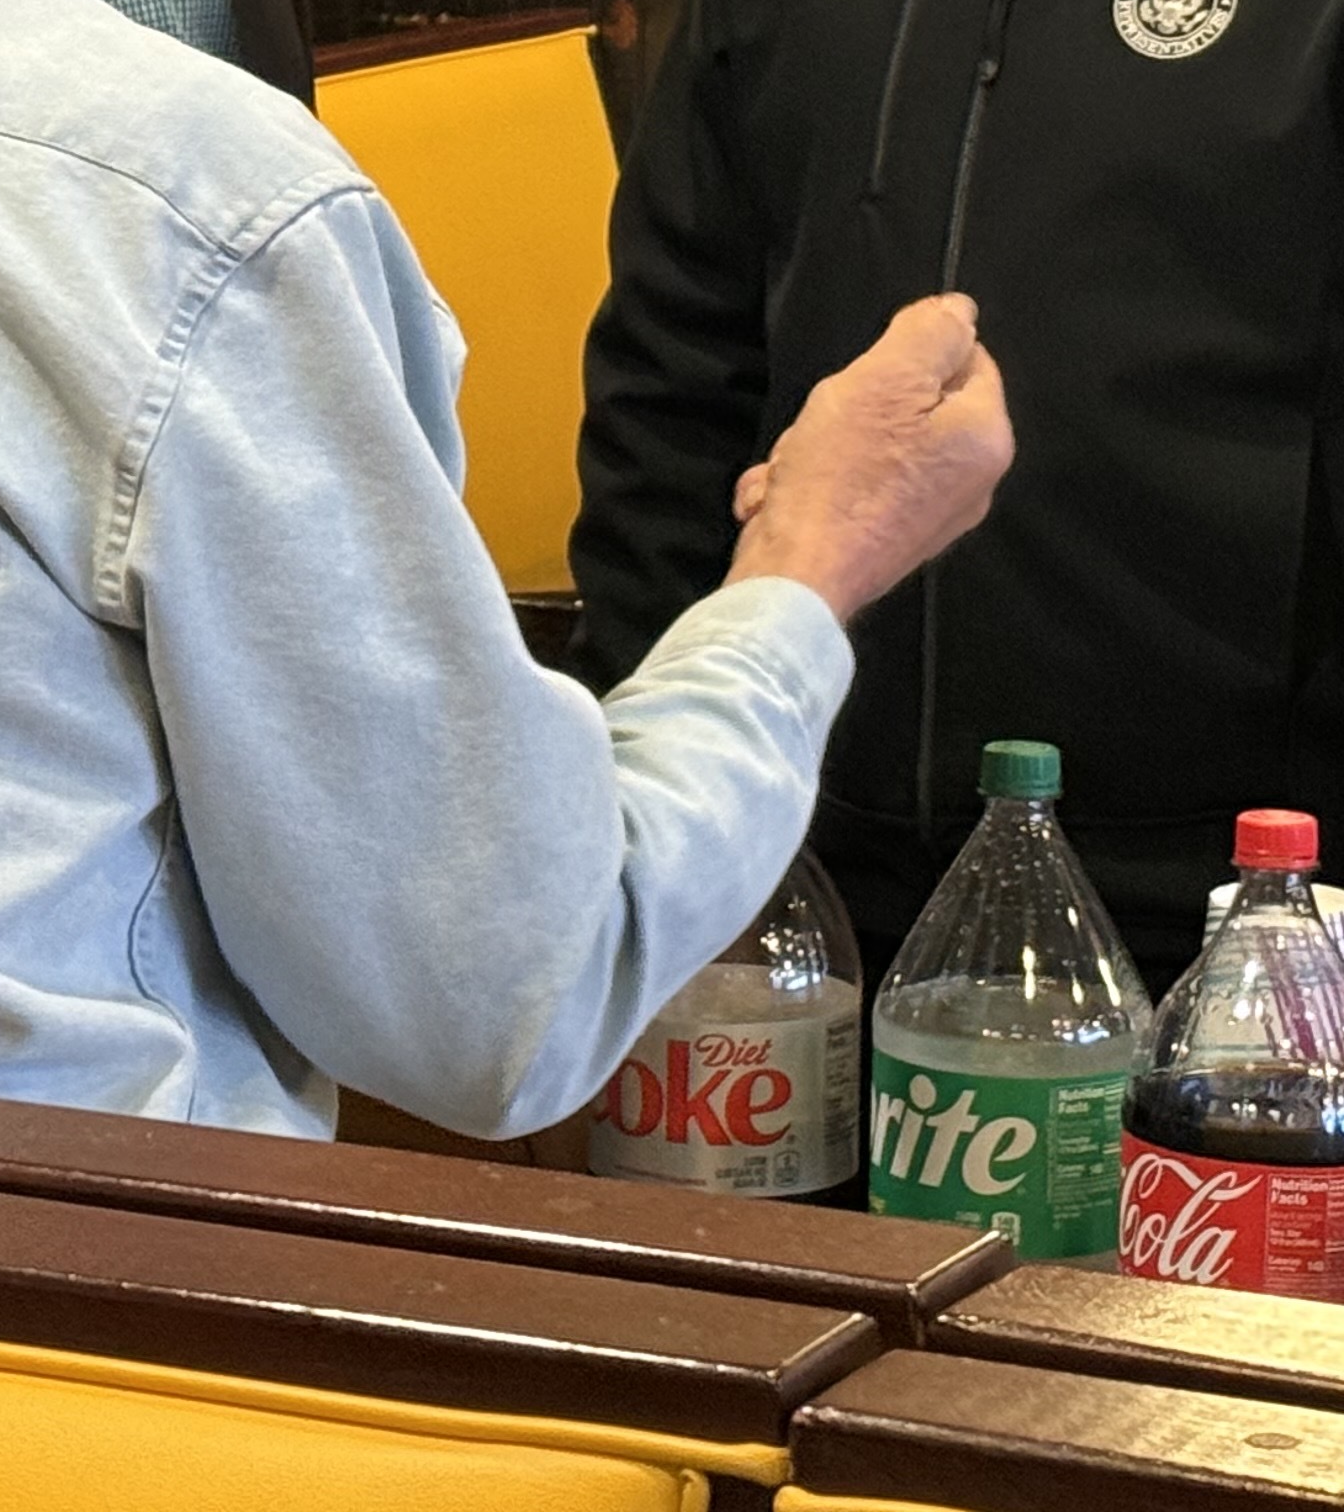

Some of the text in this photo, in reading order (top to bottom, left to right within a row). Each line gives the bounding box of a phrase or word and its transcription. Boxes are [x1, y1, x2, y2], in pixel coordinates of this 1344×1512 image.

[594, 1040, 792, 1146] oke
[695, 1034, 773, 1067] Diet
[870, 1073, 1038, 1196] rite
[1119, 1153, 1264, 1285] Cola
